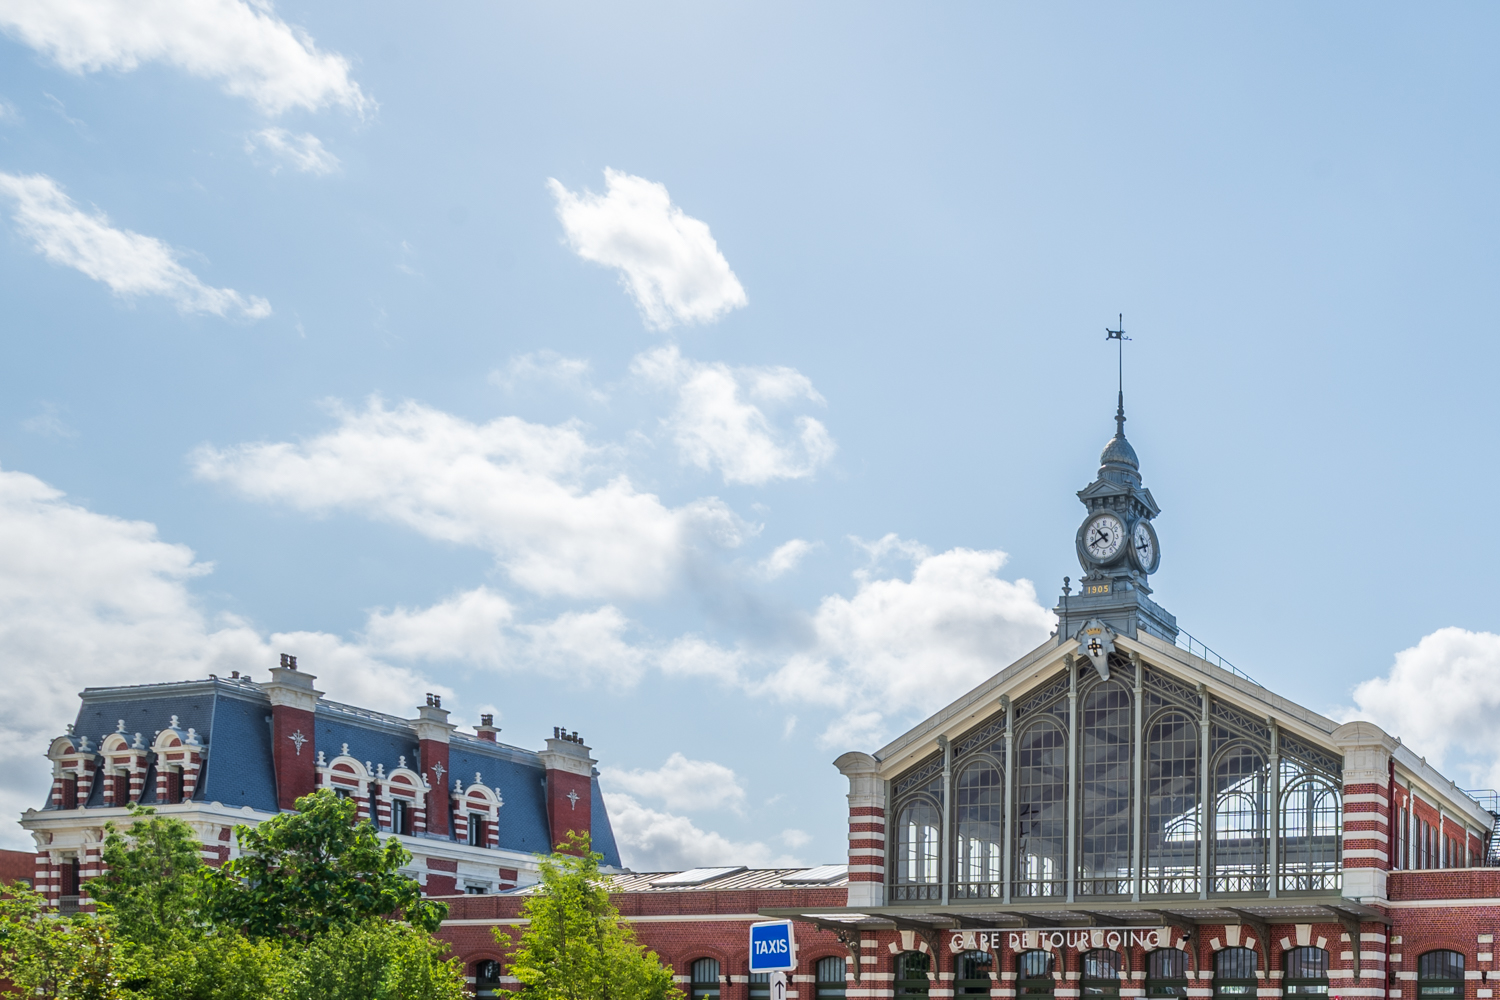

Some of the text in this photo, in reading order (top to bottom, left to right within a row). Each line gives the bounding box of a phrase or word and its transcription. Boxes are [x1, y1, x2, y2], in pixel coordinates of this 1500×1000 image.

[754, 938, 788, 955] TAXIS
[951, 931, 1161, 949] GARE DE TOURCOING
